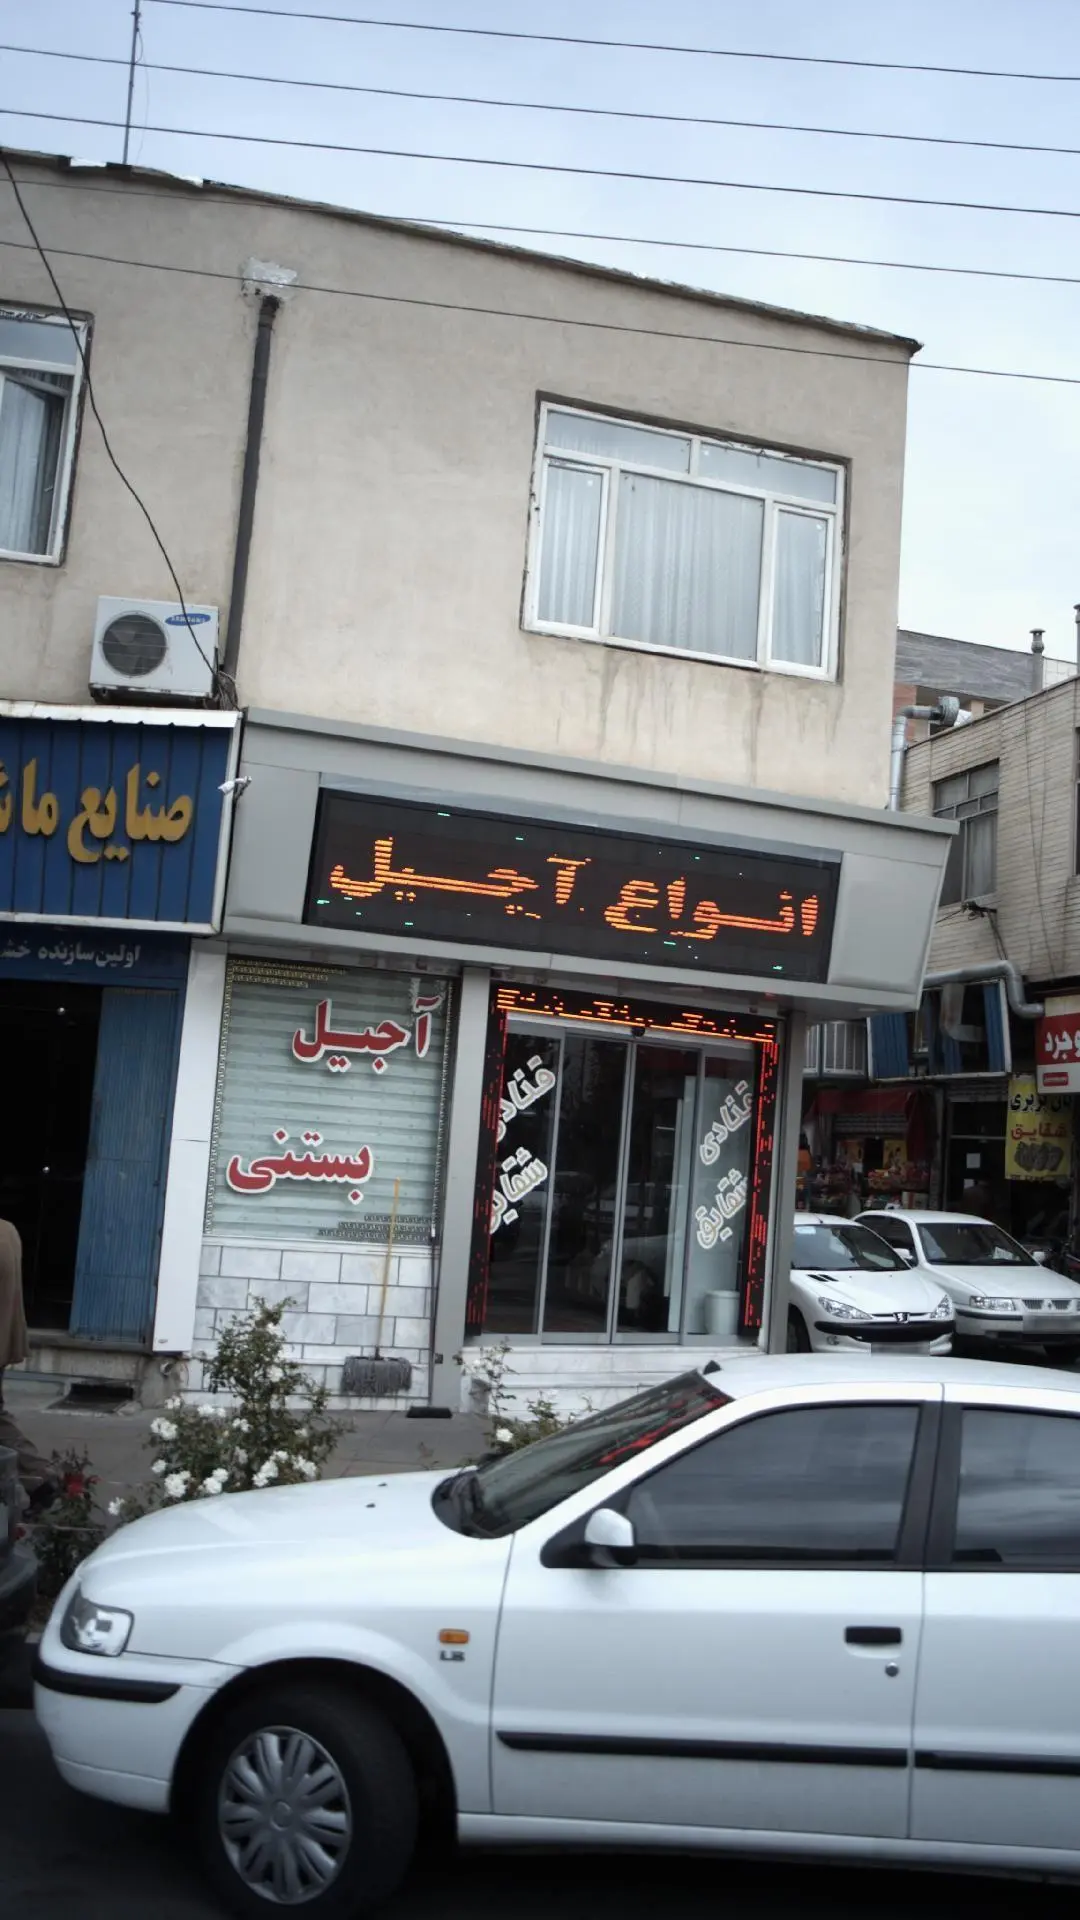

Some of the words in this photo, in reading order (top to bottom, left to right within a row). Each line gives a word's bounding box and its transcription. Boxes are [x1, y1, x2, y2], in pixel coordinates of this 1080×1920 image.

[67, 763, 193, 863] صنایع
[603, 877, 818, 940] انواع
[0, 939, 31, 958] خش
[38, 941, 95, 965] سازنده
[95, 944, 141, 968] اولین
[292, 996, 442, 1073] آجیل
[1044, 1030, 1080, 1060] وجرد
[226, 1128, 374, 1205] بستنی
